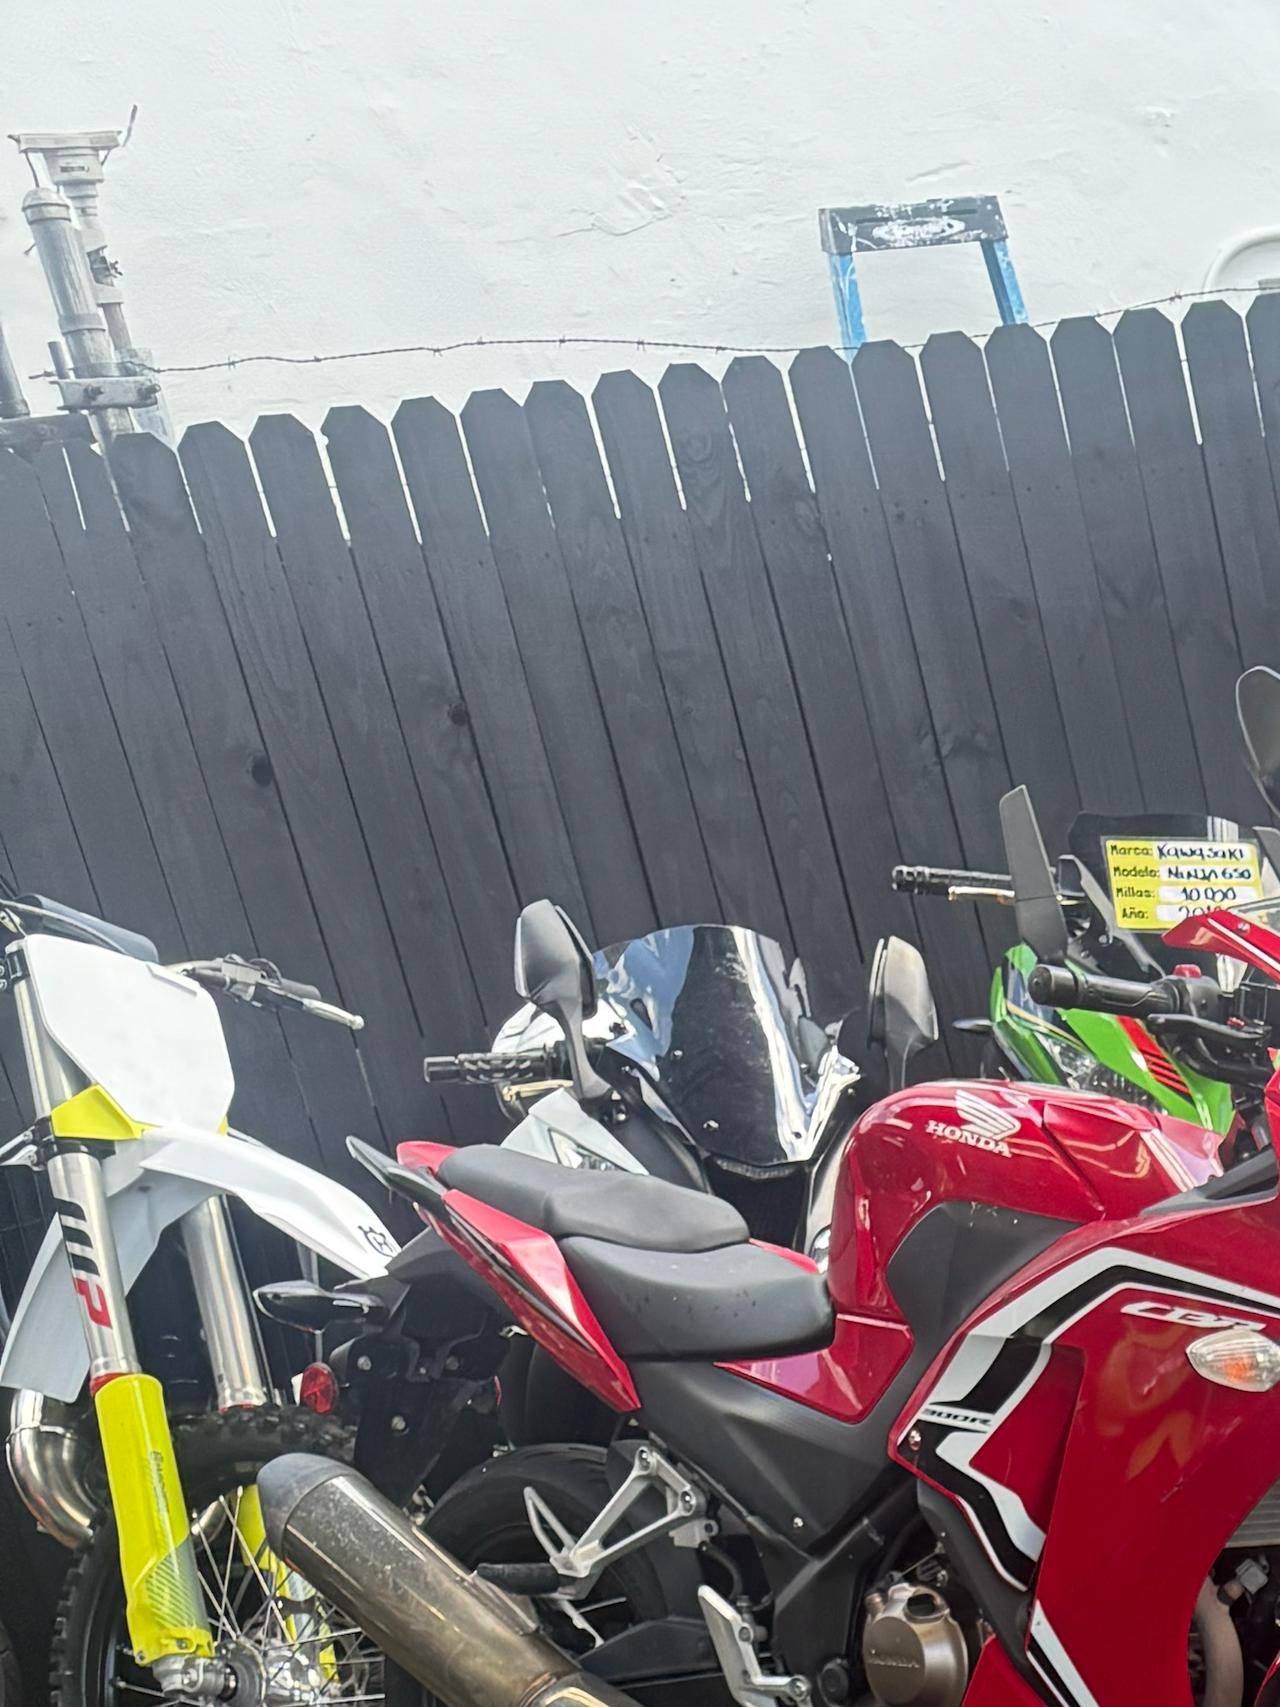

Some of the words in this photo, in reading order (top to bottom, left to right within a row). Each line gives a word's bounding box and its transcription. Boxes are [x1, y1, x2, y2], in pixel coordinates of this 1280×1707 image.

[1110, 844, 1154, 858] Marca:
[1113, 866, 1161, 879] Modelo:
[1116, 886, 1156, 899] Millas:
[1122, 907, 1150, 920] Año:
[925, 1120, 1012, 1158] HONDA
[1120, 1300, 1267, 1332] CBR
